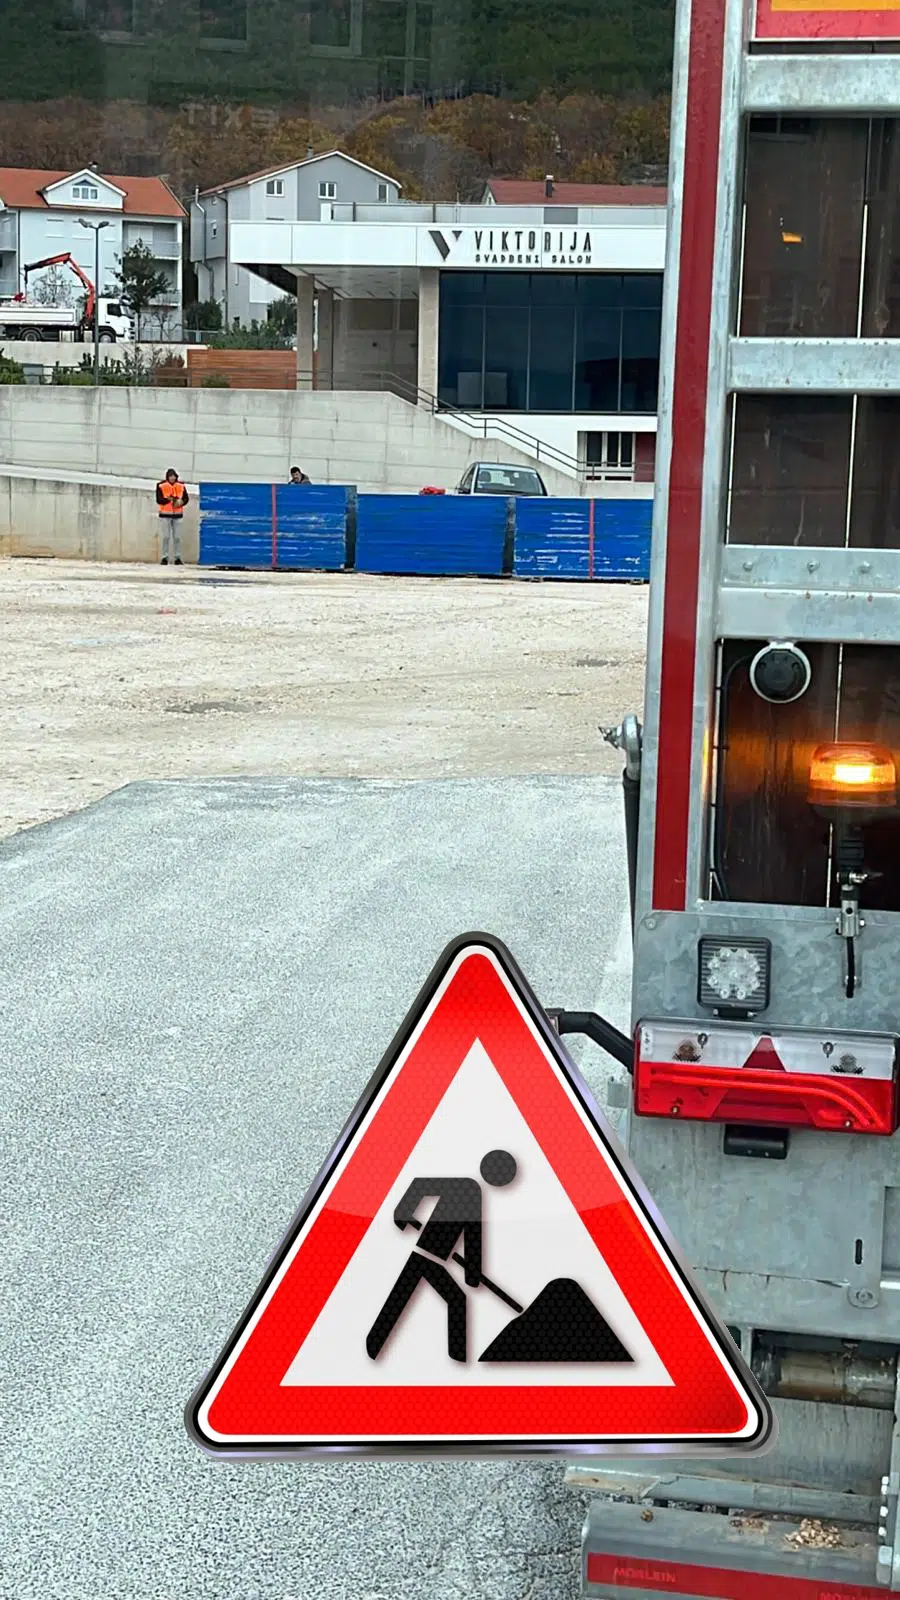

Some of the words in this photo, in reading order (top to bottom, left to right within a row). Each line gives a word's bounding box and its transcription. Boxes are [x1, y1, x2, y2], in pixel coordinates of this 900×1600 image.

[474, 230, 592, 252] VIKTORIJA
[475, 253, 540, 264] SVADBENI
[552, 254, 592, 265] SALON
